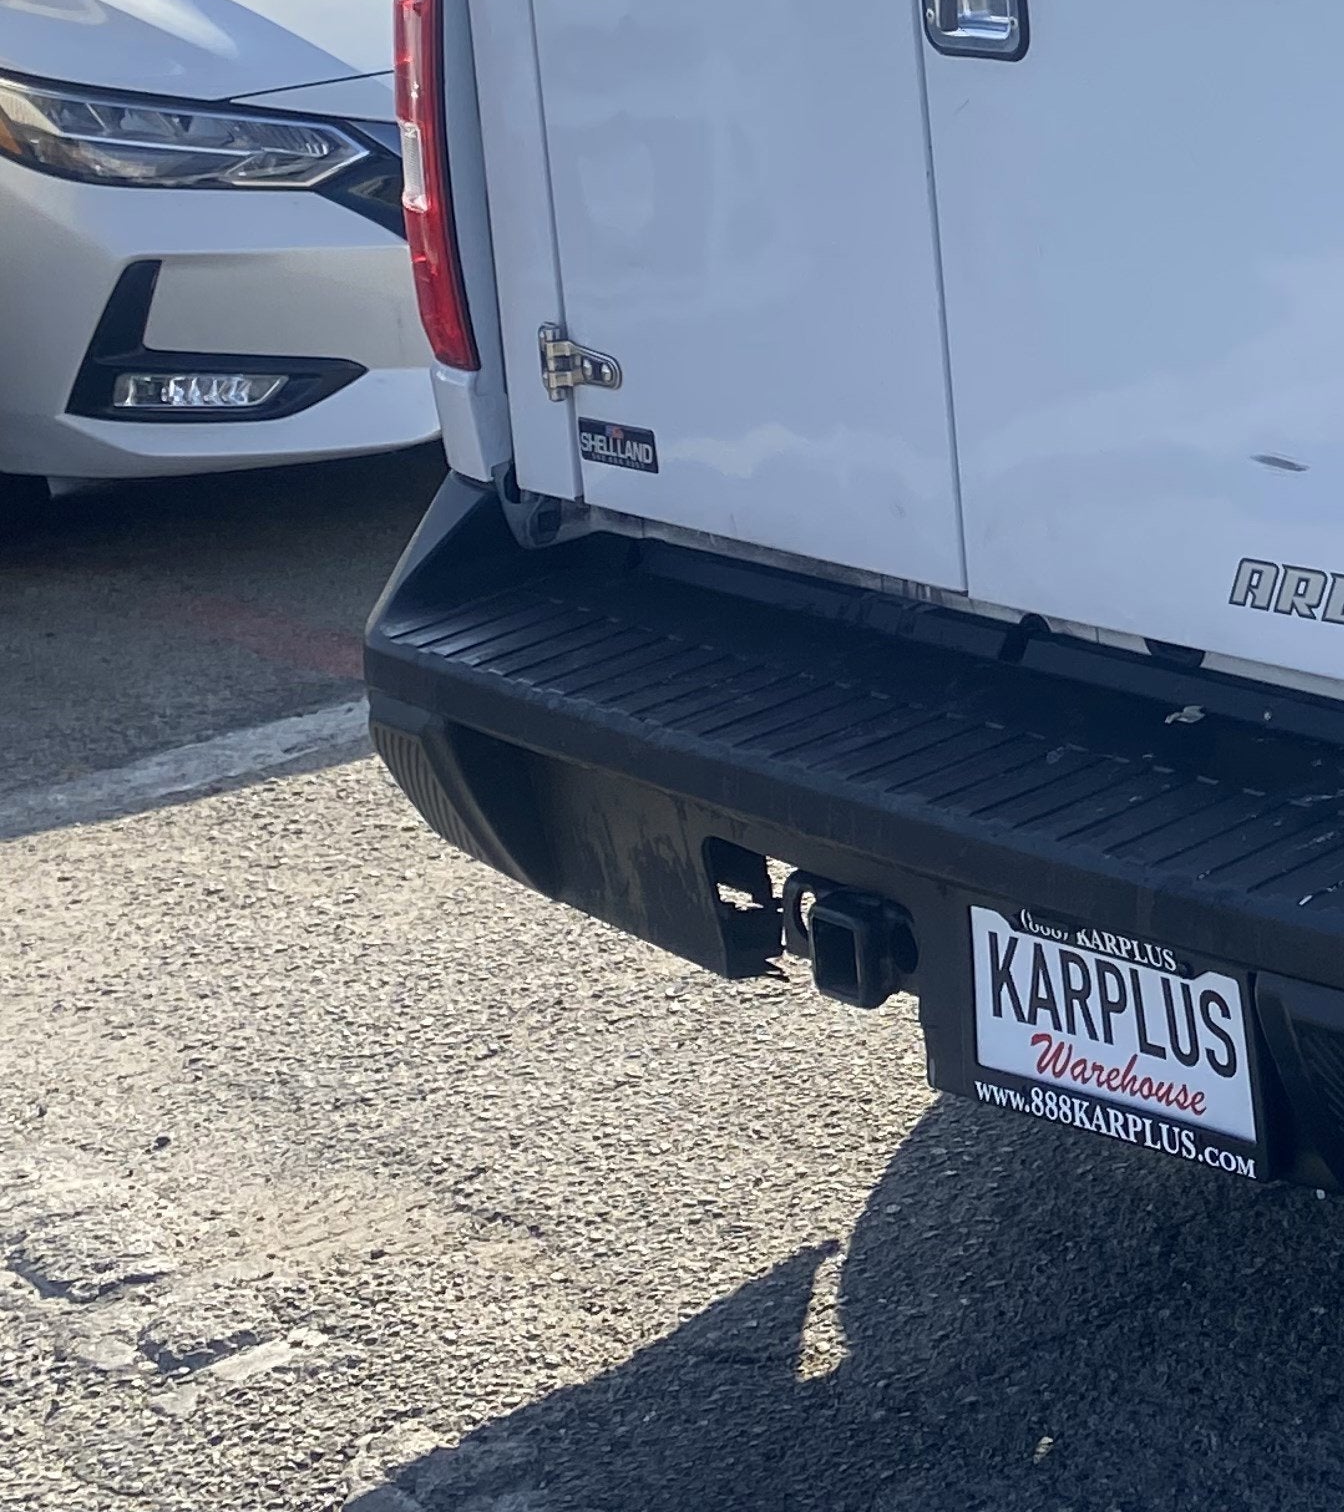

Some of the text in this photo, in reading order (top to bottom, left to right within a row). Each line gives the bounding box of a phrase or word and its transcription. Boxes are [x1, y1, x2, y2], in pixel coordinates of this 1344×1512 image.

[1076, 928, 1178, 972] KARPLUS
[987, 929, 1238, 1078] KARPLUS
[1030, 1033, 1208, 1117] Warehouse
